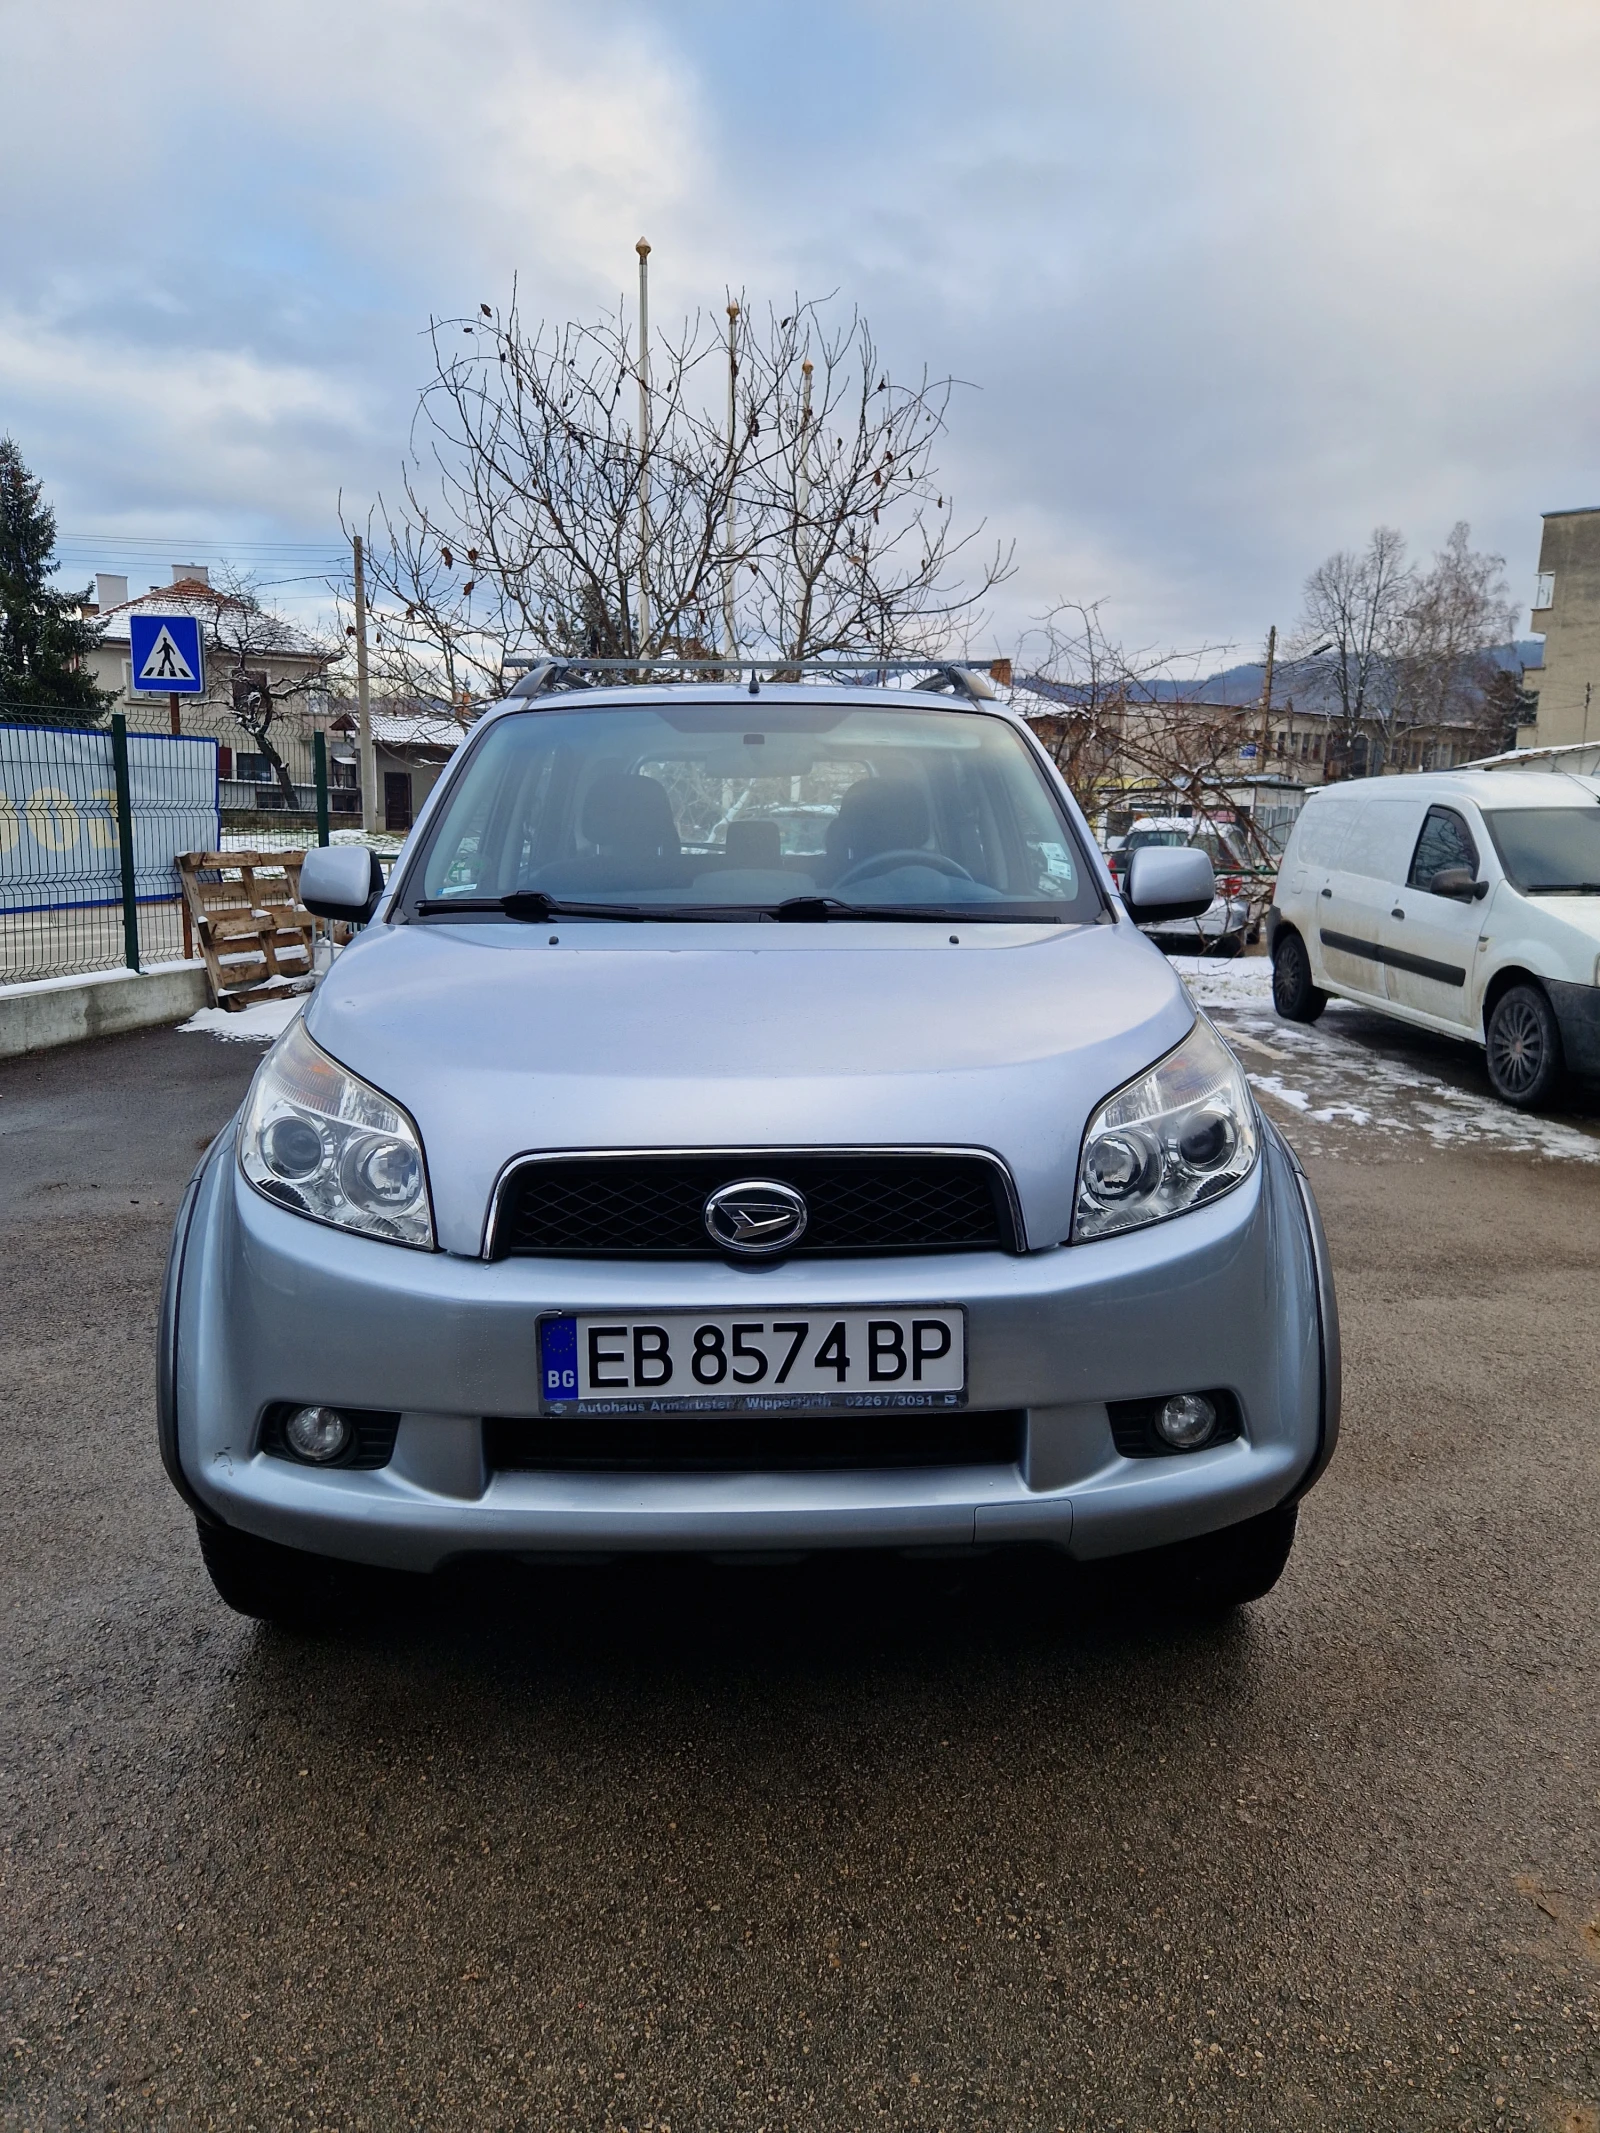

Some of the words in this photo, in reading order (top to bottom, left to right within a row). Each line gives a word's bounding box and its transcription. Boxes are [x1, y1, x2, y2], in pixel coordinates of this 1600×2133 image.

[588, 1325, 673, 1388] EB
[691, 1321, 851, 1385] 8574
[867, 1319, 952, 1382] BP
[548, 1370, 575, 1388] BG
[577, 1401, 645, 1414] Autohaus
[846, 1394, 933, 1407] 02267/3091
